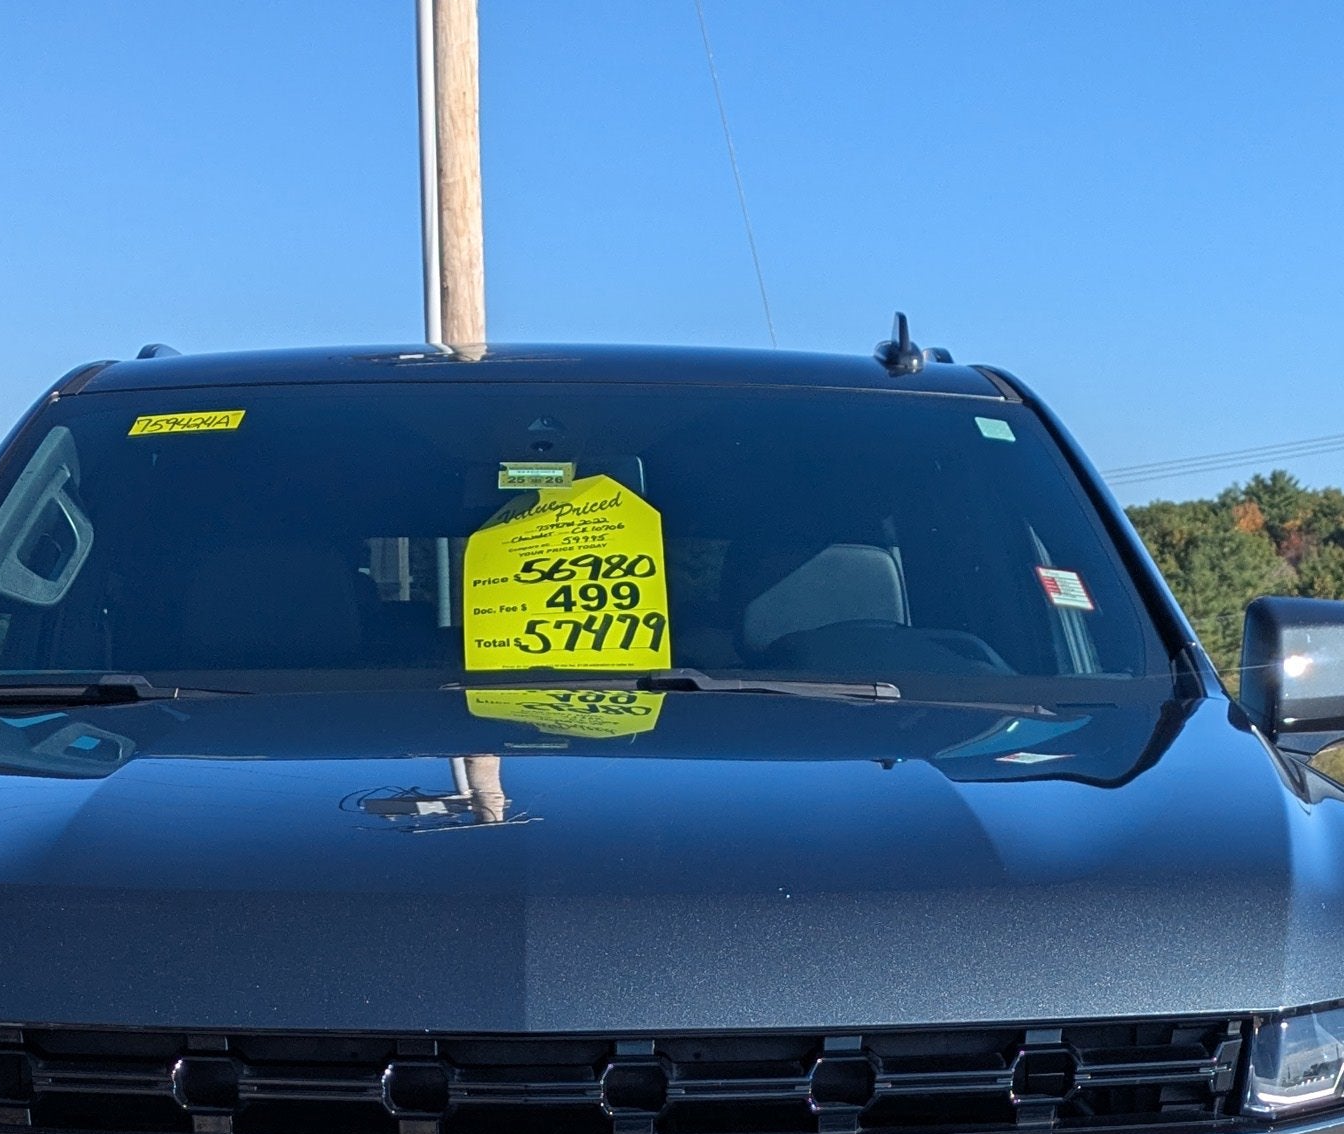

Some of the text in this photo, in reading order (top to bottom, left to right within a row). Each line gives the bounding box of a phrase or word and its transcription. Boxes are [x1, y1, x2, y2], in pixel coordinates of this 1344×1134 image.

[508, 476, 525, 484] 25
[545, 476, 564, 484] 26
[554, 491, 623, 522] Priced
[546, 546, 575, 554] PRICE
[473, 576, 509, 587] Price
[516, 554, 657, 584] 56980
[473, 607, 497, 615] Doc.
[499, 605, 518, 613] Fee
[545, 581, 641, 613] 499
[475, 638, 511, 649] Total
[519, 612, 667, 654] 57479
